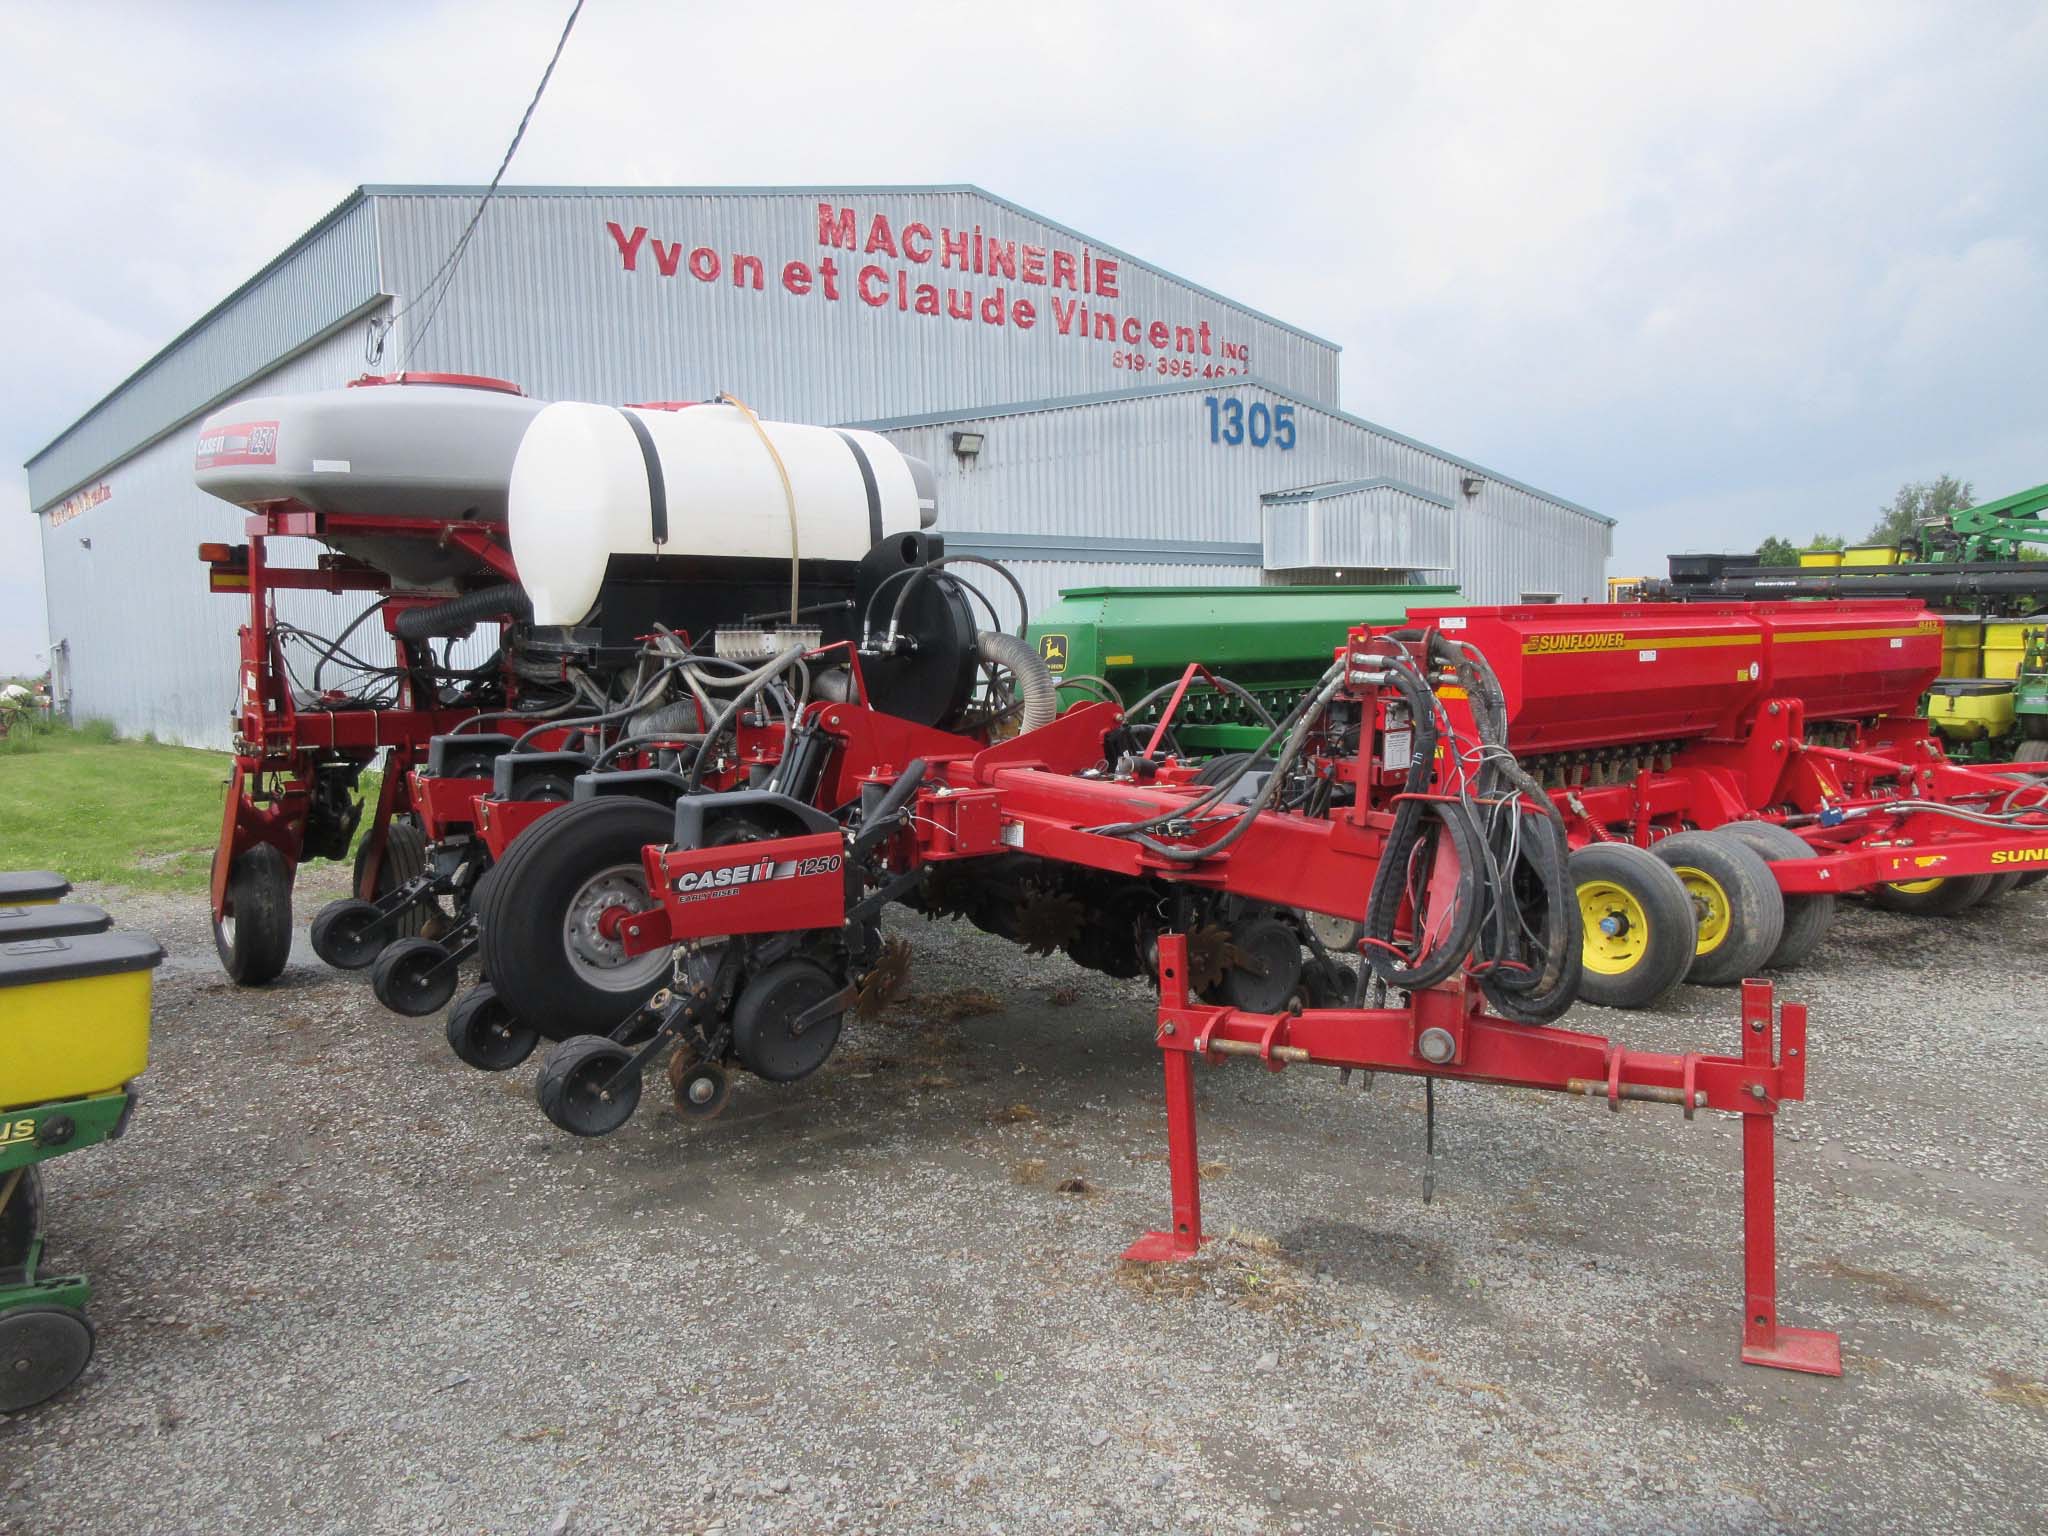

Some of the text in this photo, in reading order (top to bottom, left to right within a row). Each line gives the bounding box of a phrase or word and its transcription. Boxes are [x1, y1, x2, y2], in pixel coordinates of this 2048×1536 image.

[606, 221, 764, 290] Yvon
[782, 256, 839, 301] et
[857, 264, 1037, 329] Claude
[1051, 296, 1212, 356] Vincent
[1205, 395, 1297, 450] 1305
[1540, 632, 1626, 651] SUNFLOWER
[678, 864, 751, 893] CASE
[798, 855, 841, 877] 1250
[678, 888, 740, 904] EARLY RISER
